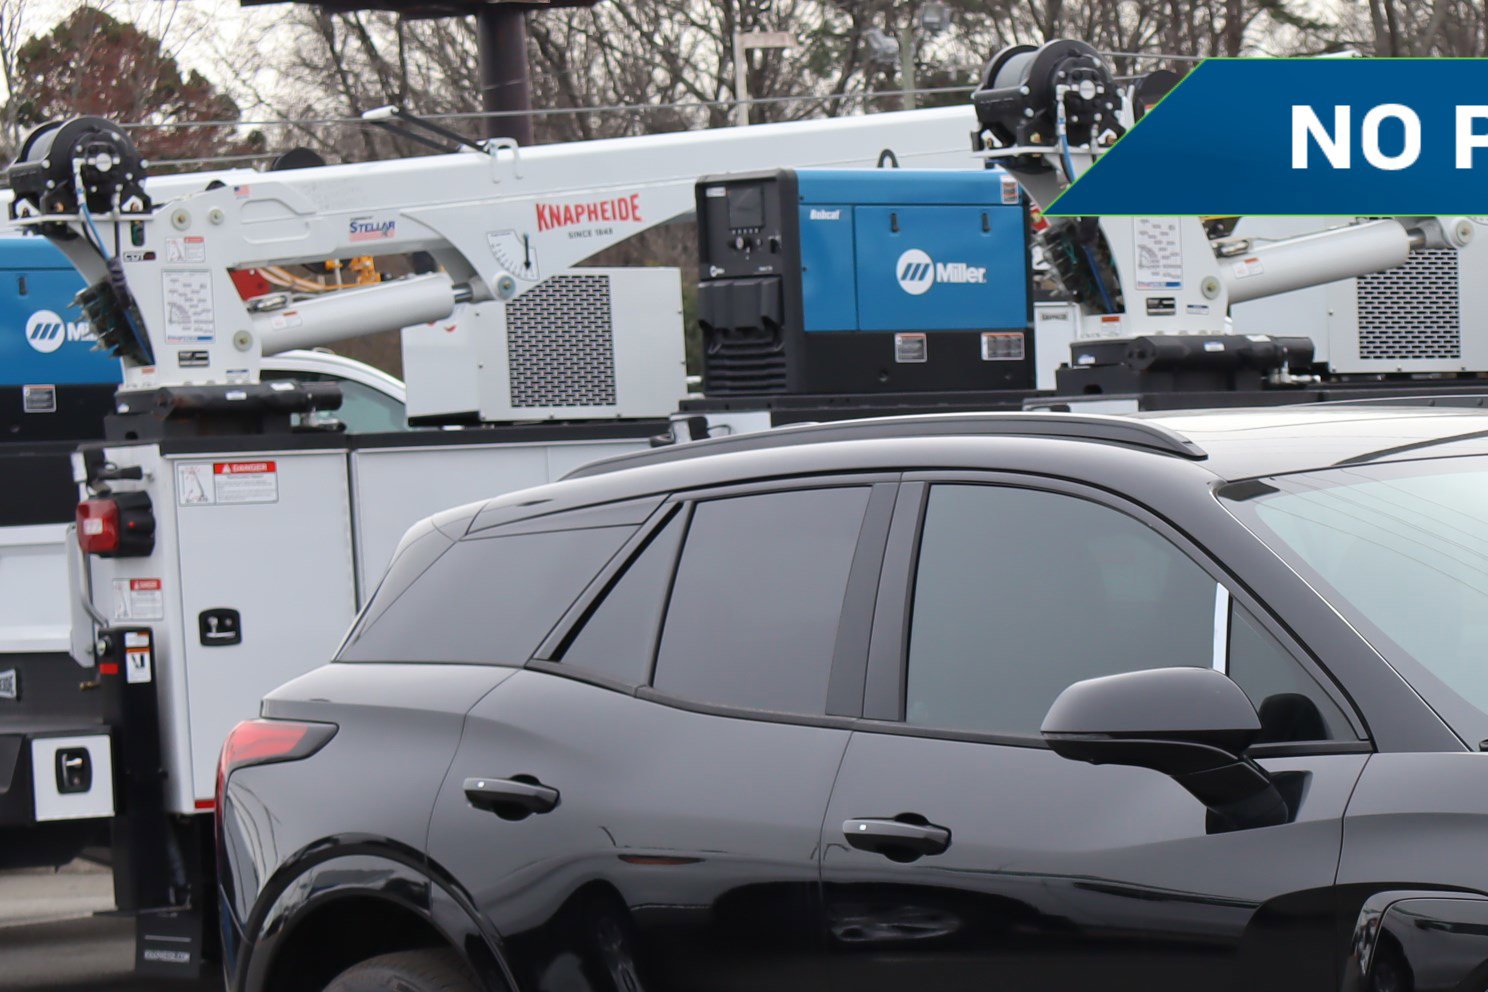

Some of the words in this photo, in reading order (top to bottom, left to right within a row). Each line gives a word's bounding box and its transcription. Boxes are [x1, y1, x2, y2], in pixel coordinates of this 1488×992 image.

[536, 193, 643, 232] KNAPHEIDE
[810, 209, 840, 220] Bobcat
[350, 220, 396, 233] STELLAR
[568, 230, 593, 240] SINCE
[936, 262, 987, 283] Miller
